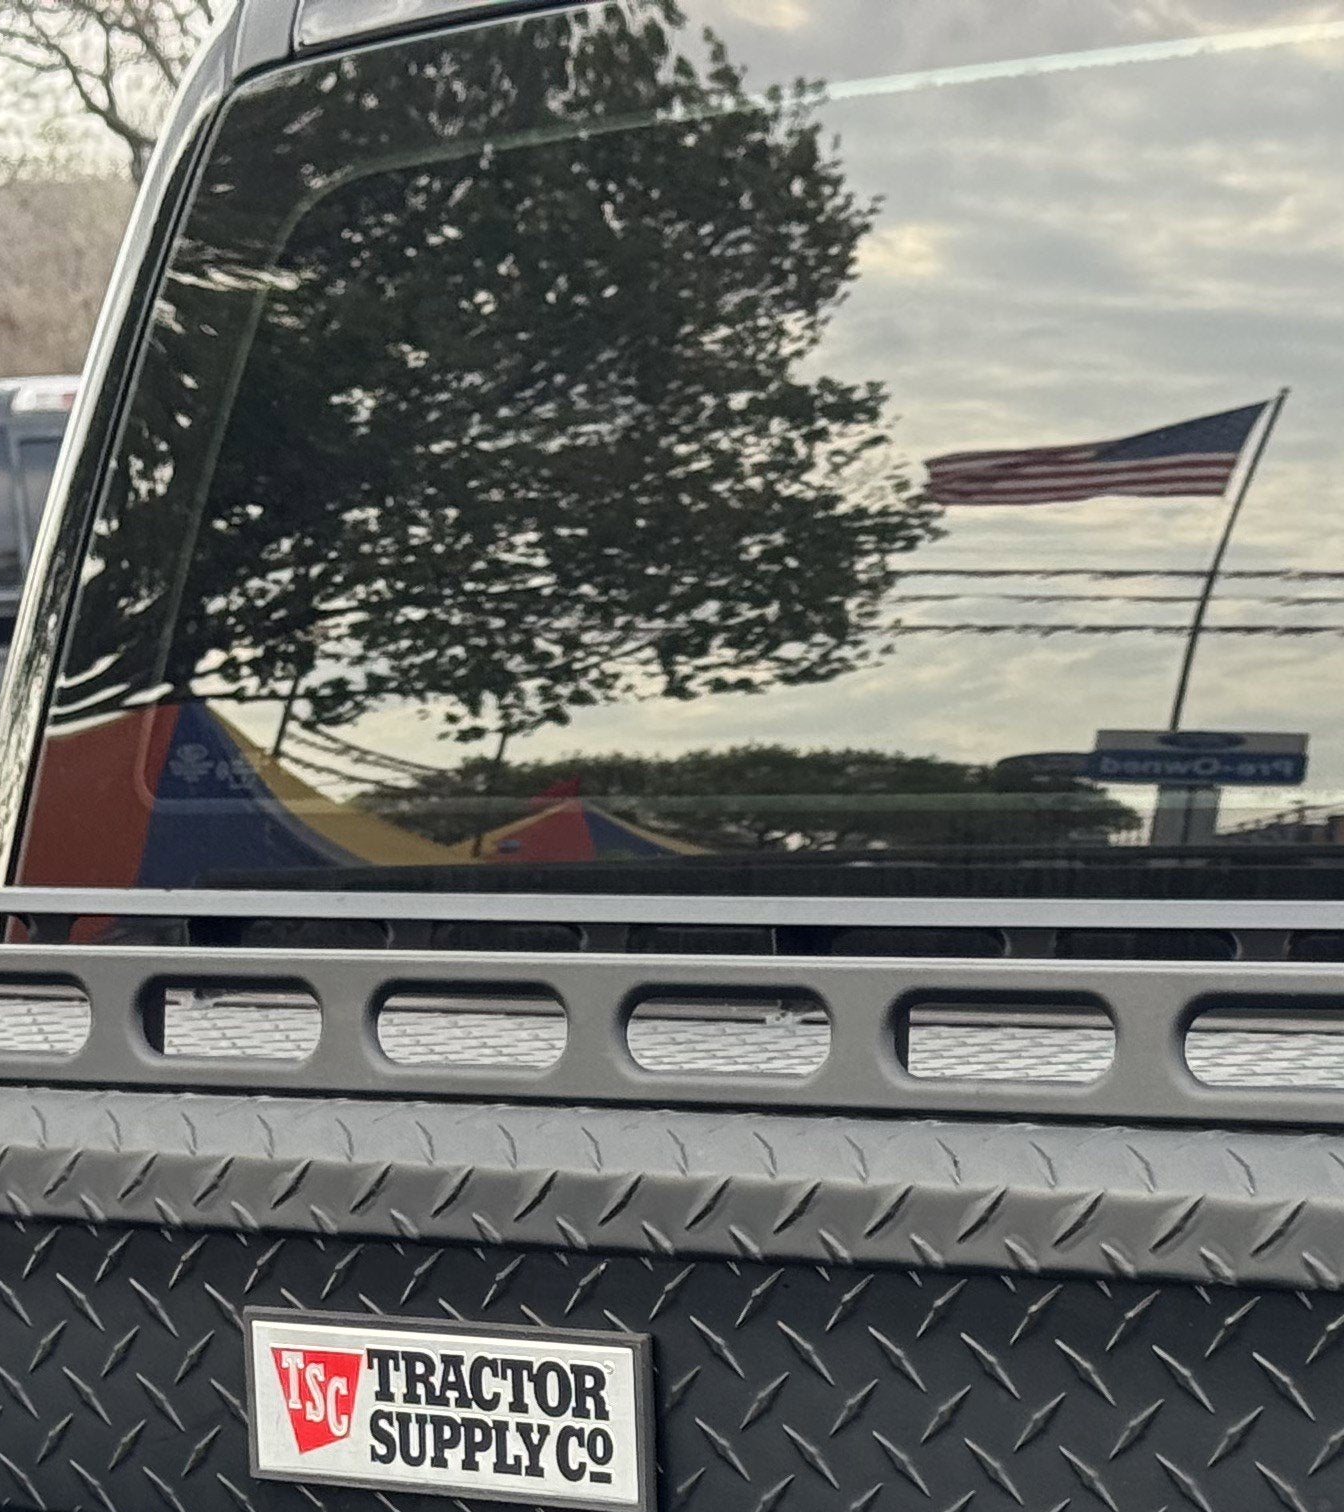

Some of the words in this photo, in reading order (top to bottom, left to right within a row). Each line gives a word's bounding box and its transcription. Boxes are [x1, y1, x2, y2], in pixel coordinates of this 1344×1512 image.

[280, 1349, 349, 1438] TSC
[366, 1348, 611, 1421] TRACTOR
[369, 1409, 551, 1478] SUPPLY
